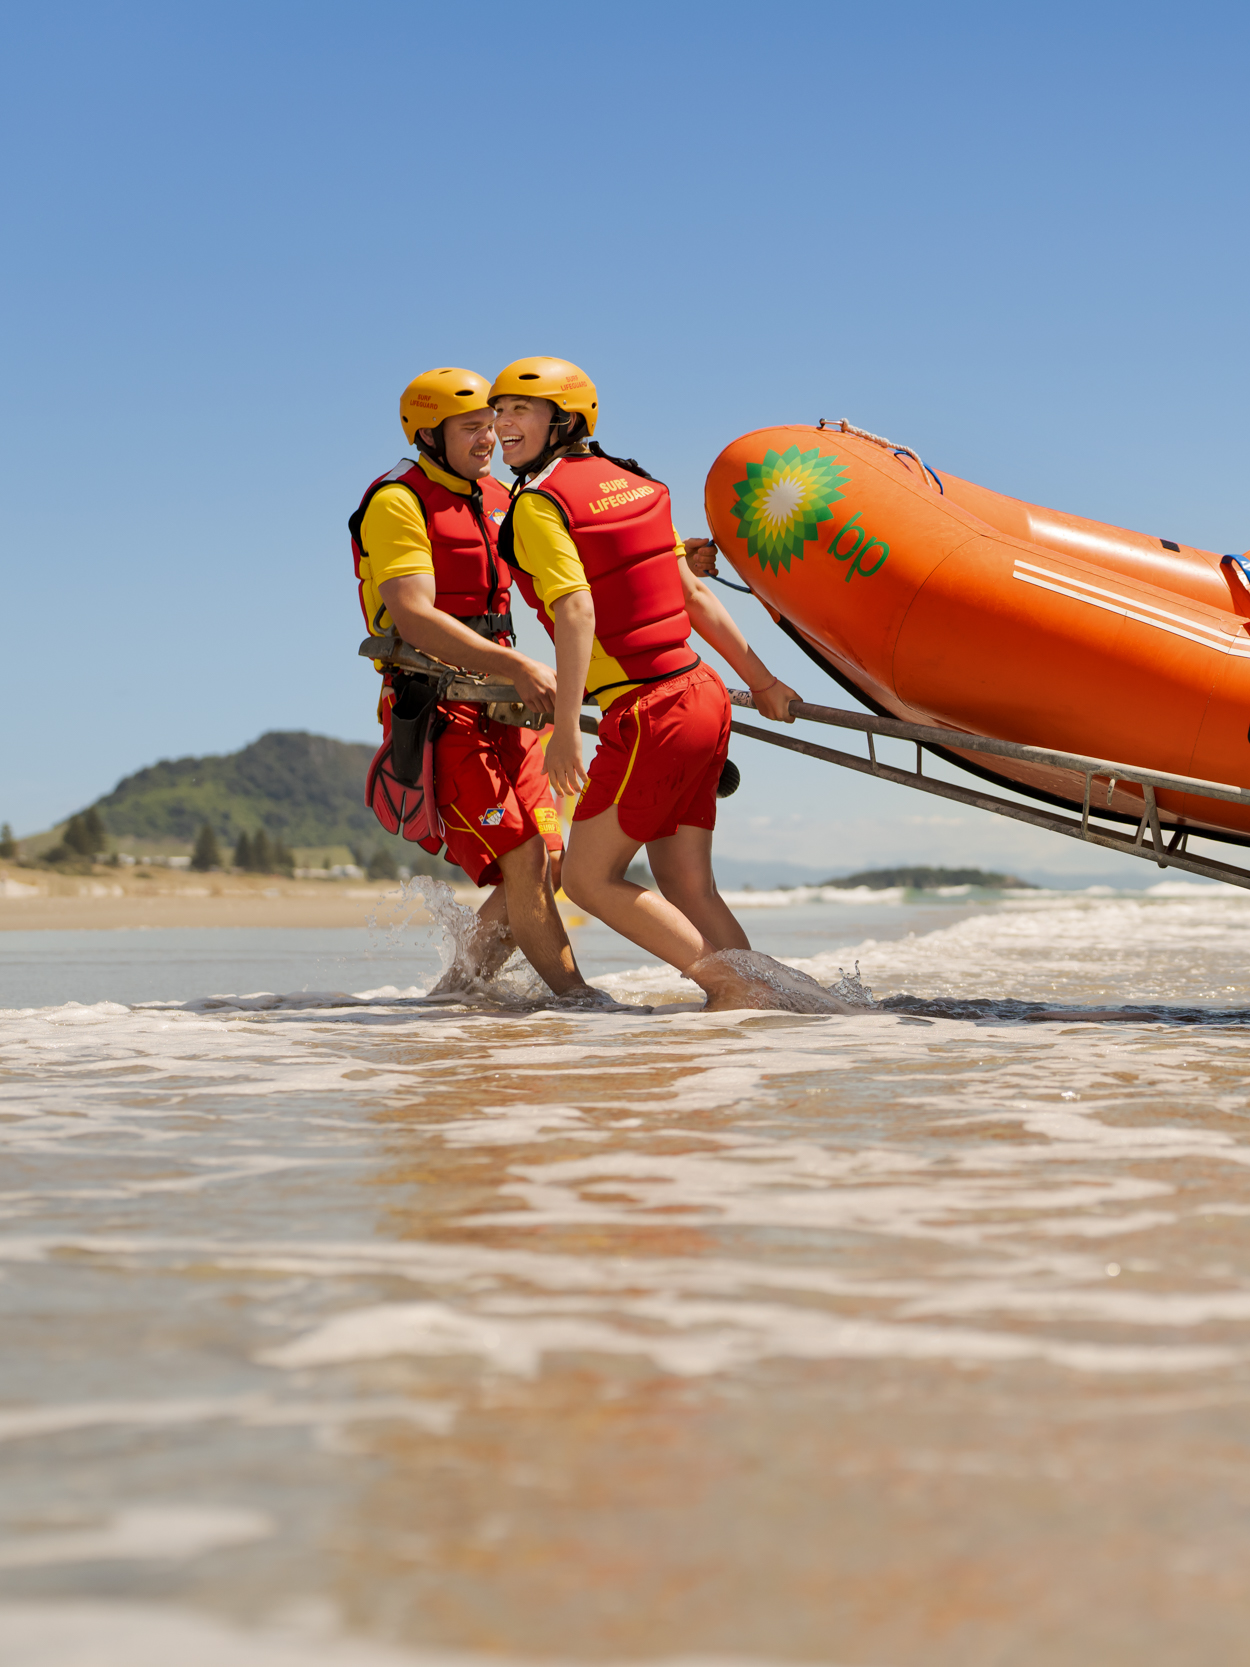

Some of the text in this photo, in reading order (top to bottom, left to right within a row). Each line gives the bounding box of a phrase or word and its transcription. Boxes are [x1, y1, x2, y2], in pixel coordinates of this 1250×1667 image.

[410, 399, 438, 410] LIFEGUARD
[599, 478, 629, 494] SURF
[588, 485, 655, 515] LIFEGUARD
[827, 510, 890, 583] bp
